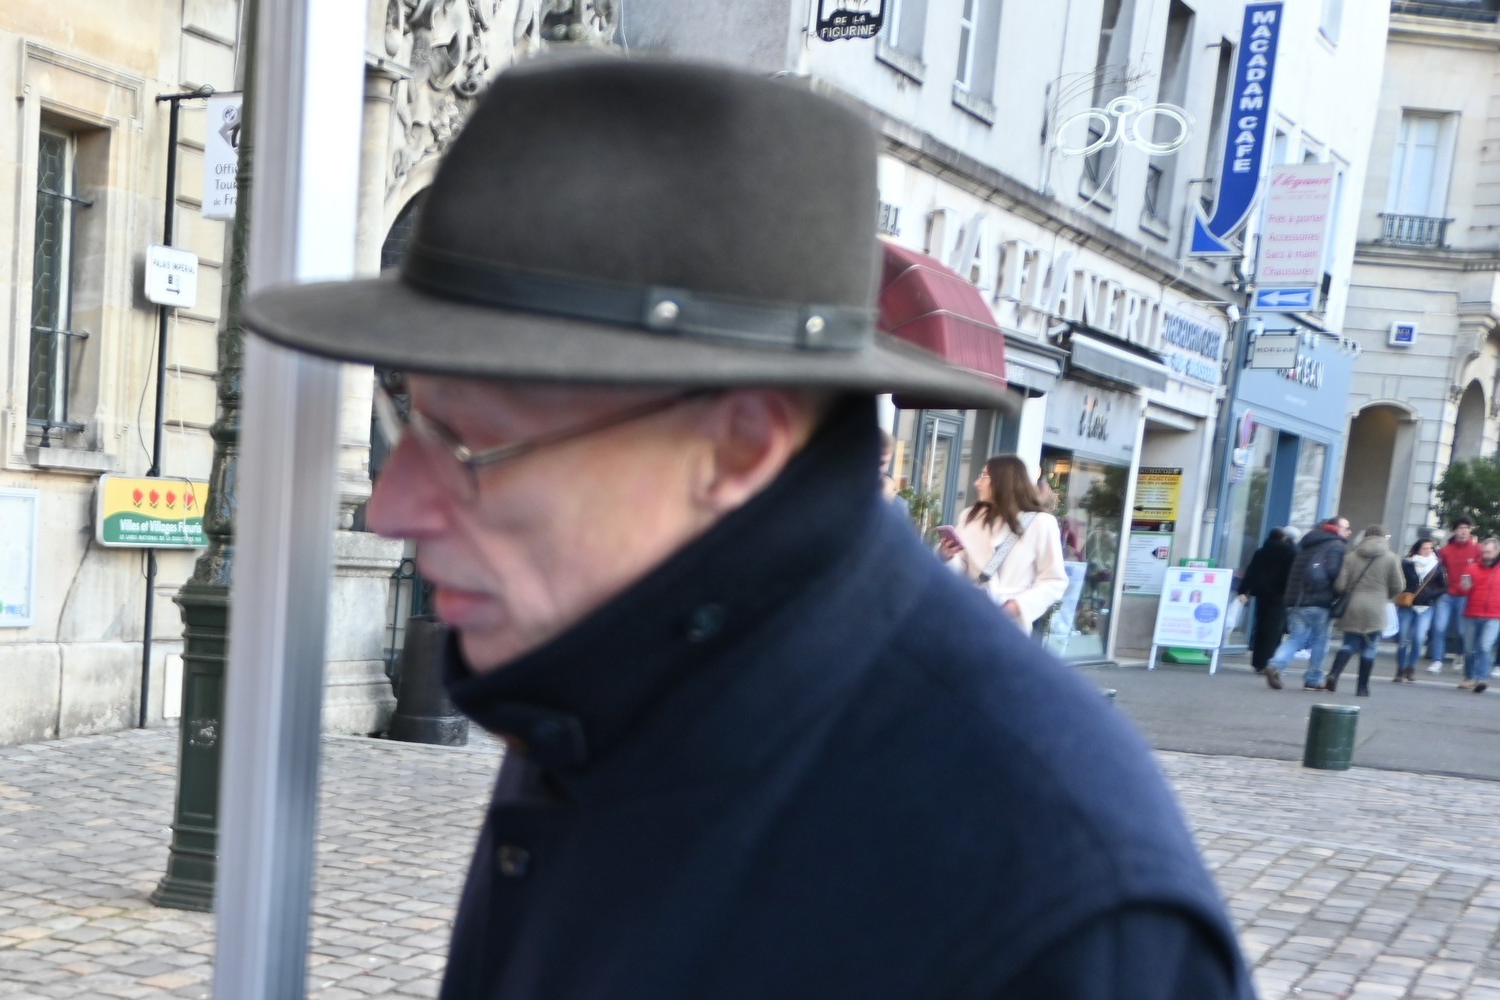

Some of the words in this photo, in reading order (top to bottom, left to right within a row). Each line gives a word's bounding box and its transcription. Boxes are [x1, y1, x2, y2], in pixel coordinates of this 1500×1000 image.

[821, 24, 876, 38] FIGURINE
[1238, 10, 1276, 111] MACADAM
[1232, 116, 1258, 173] CAFE
[153, 258, 171, 269] PALAIS
[120, 519, 139, 531] Villes
[141, 520, 149, 531] et
[150, 520, 177, 535] Villages
